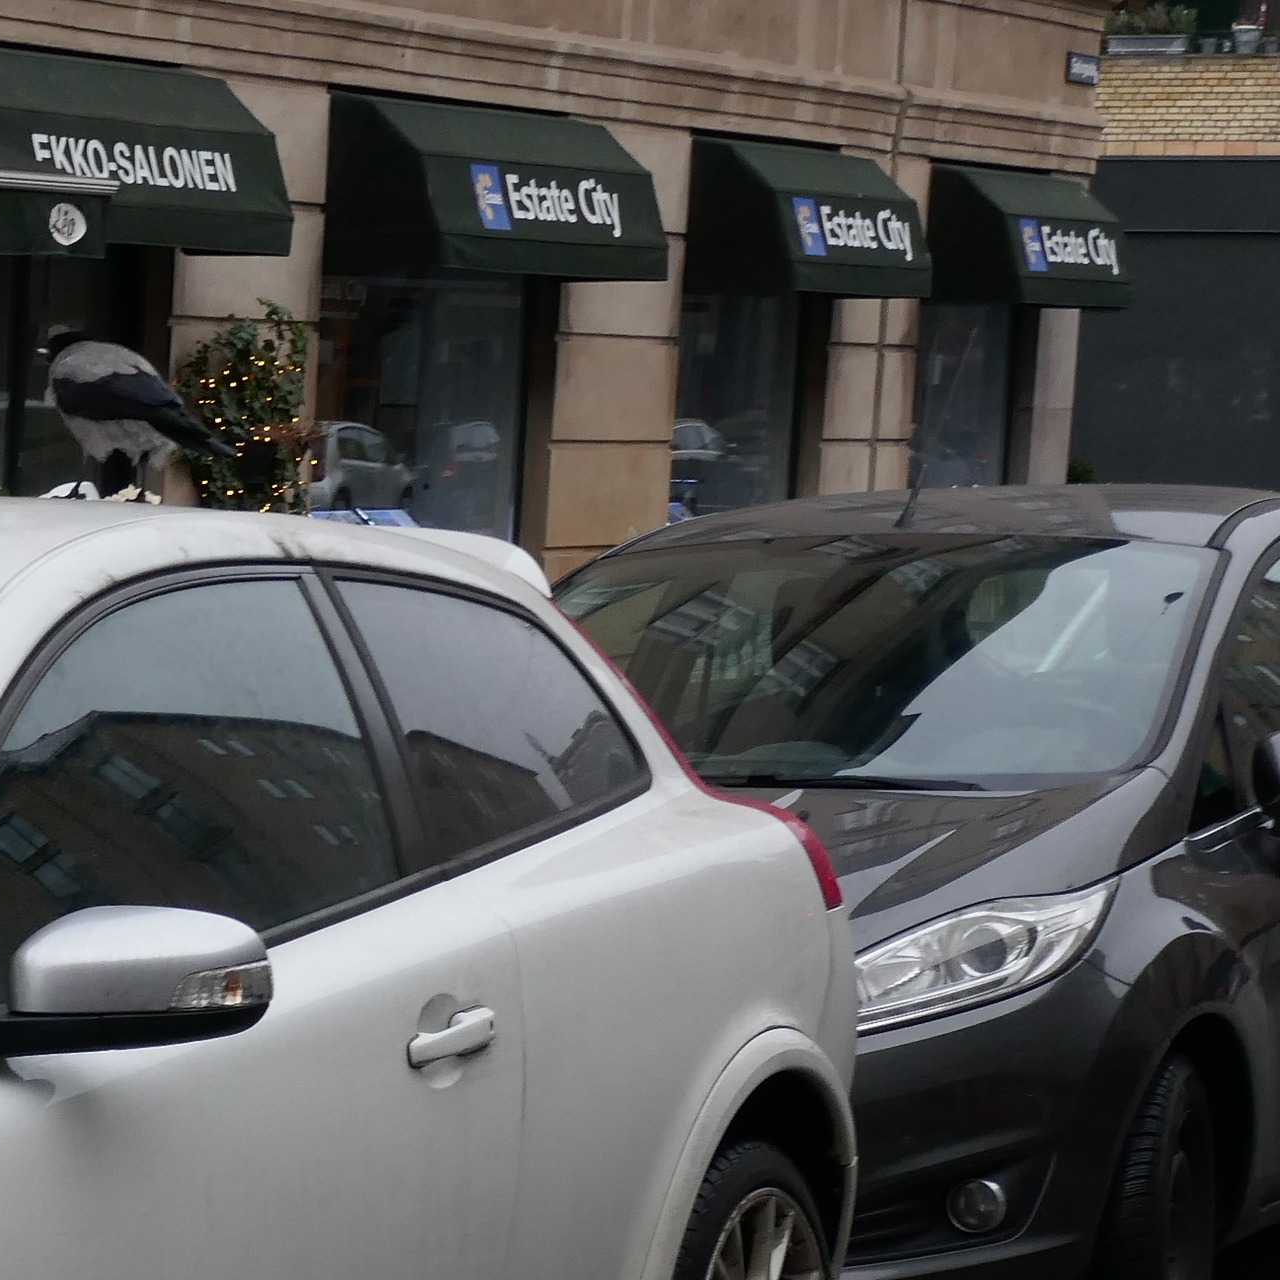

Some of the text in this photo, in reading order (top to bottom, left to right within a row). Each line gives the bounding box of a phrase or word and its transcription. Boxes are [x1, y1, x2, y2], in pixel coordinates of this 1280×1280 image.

[31, 133, 238, 192] EKKO-SALONEN
[505, 173, 623, 239] Estate City
[819, 205, 914, 262] Estate City
[1040, 225, 1121, 276] Estate City
